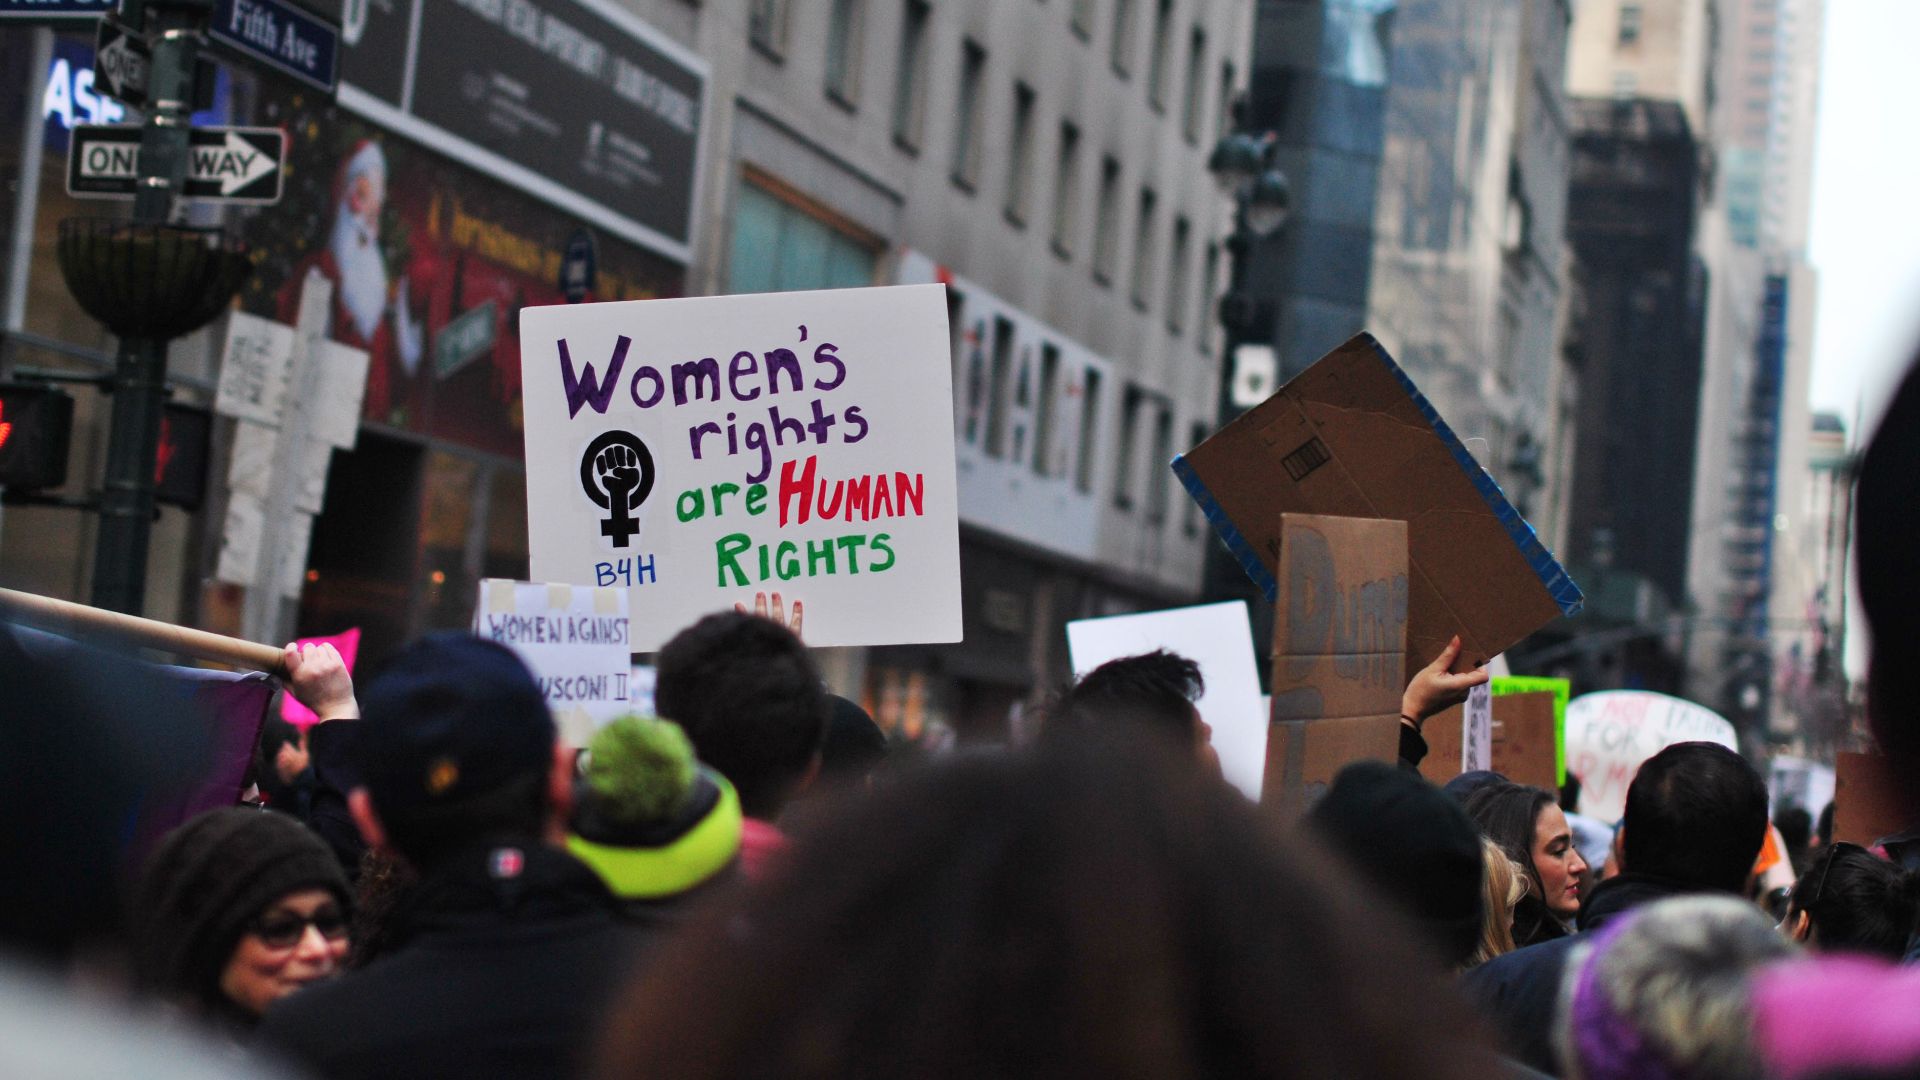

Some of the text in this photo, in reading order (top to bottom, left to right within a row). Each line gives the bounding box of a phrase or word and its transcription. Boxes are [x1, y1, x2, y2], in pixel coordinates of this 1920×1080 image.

[230, 0, 277, 52] Fifth
[280, 22, 318, 70] Ave
[88, 146, 257, 178] ON WAY
[557, 325, 847, 420] Women's
[688, 398, 869, 485] rights
[676, 455, 924, 528] are HUMAN
[595, 553, 657, 587] B4H
[715, 532, 897, 588] RIGHTS
[488, 613, 630, 646] WOMEN AGAINST
[537, 673, 629, 702] USCONI II
